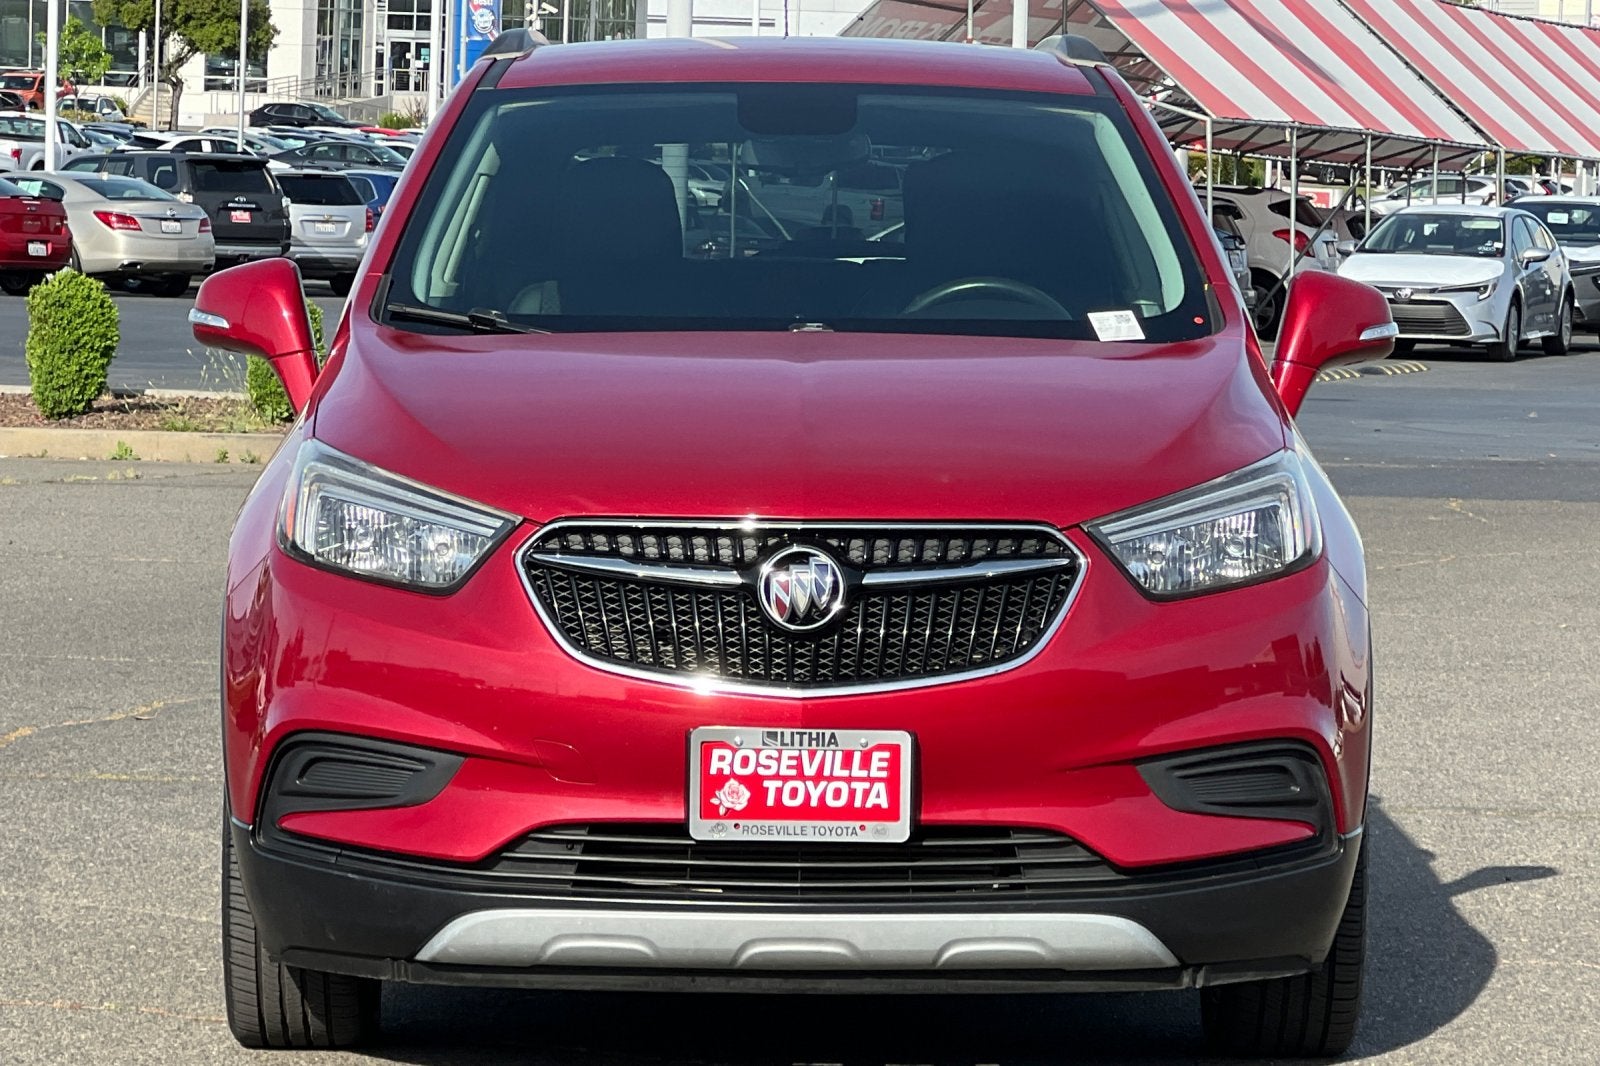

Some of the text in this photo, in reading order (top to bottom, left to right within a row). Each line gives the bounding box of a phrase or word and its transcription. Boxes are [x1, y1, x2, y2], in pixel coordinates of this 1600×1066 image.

[779, 731, 839, 748] LITHIA
[709, 748, 891, 778] ROSEVILLE
[762, 780, 889, 809] TOYOTA
[742, 824, 858, 837] ROSEVILLE TOYOTA
